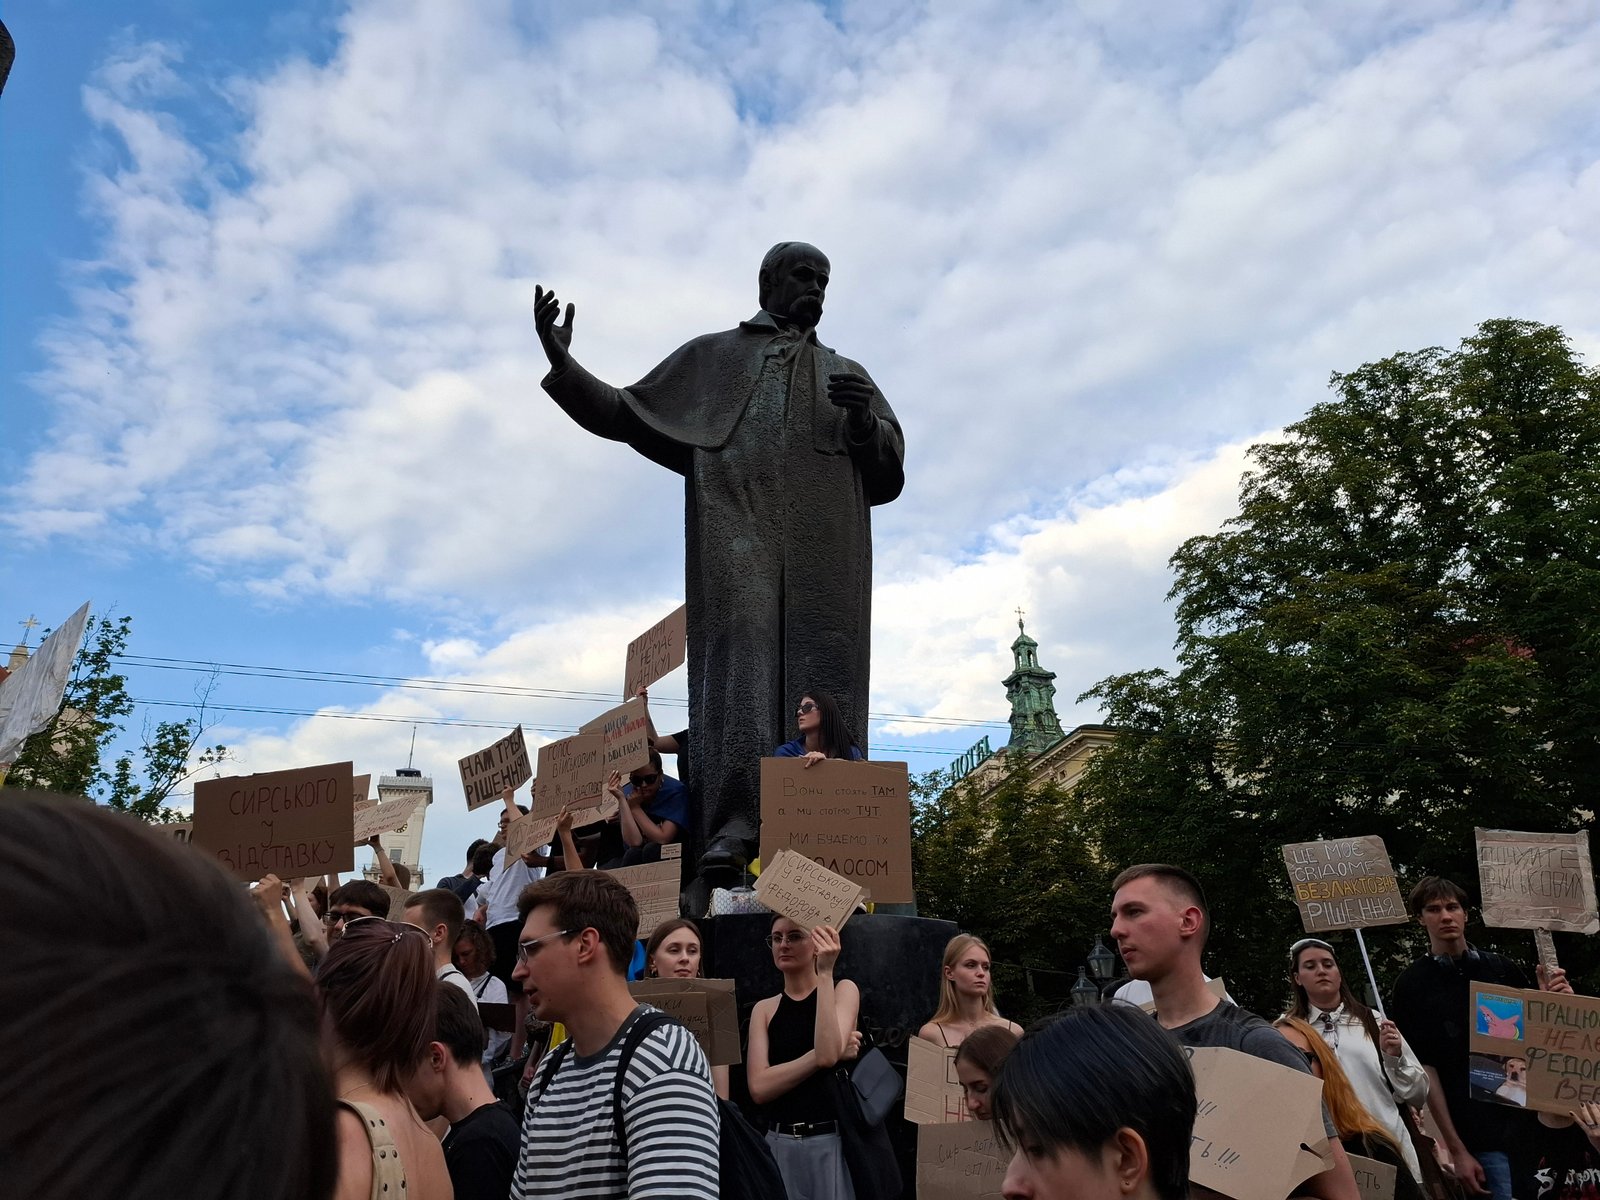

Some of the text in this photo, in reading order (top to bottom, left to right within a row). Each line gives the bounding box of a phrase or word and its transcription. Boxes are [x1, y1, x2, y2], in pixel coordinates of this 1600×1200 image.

[640, 630, 674, 667] НЕМАЄ
[628, 652, 671, 697] КАНІКУЛ
[461, 731, 525, 781] НАМ ТРЕБА
[229, 777, 338, 816] СИРСЬКОГО
[783, 777, 896, 797] Вони стоять ТАМ
[778, 808, 786, 816] а
[797, 807, 812, 816] ми
[819, 807, 851, 816] стоїмо
[261, 820, 274, 848] У
[789, 832, 809, 846] МИ
[817, 833, 867, 846] БУДЕМО
[217, 840, 336, 872] ВІДСТАВКУ
[806, 857, 889, 877] ОЛОСОМ
[1292, 841, 1365, 864] ЦЕ МОЄ
[787, 855, 851, 893] СИРСЬКОГО
[1294, 860, 1376, 882] СВІДОМЕ
[768, 882, 820, 917] ФЕДОРОВА
[782, 906, 800, 918] МО
[1306, 897, 1396, 928] РІШЕННЯ
[1528, 1000, 1600, 1030] ПРАЦЮ
[1545, 1028, 1577, 1050] НЕ
[1526, 1047, 1600, 1080] ФЕДОР
[1354, 1170, 1381, 1190] СТЬ
